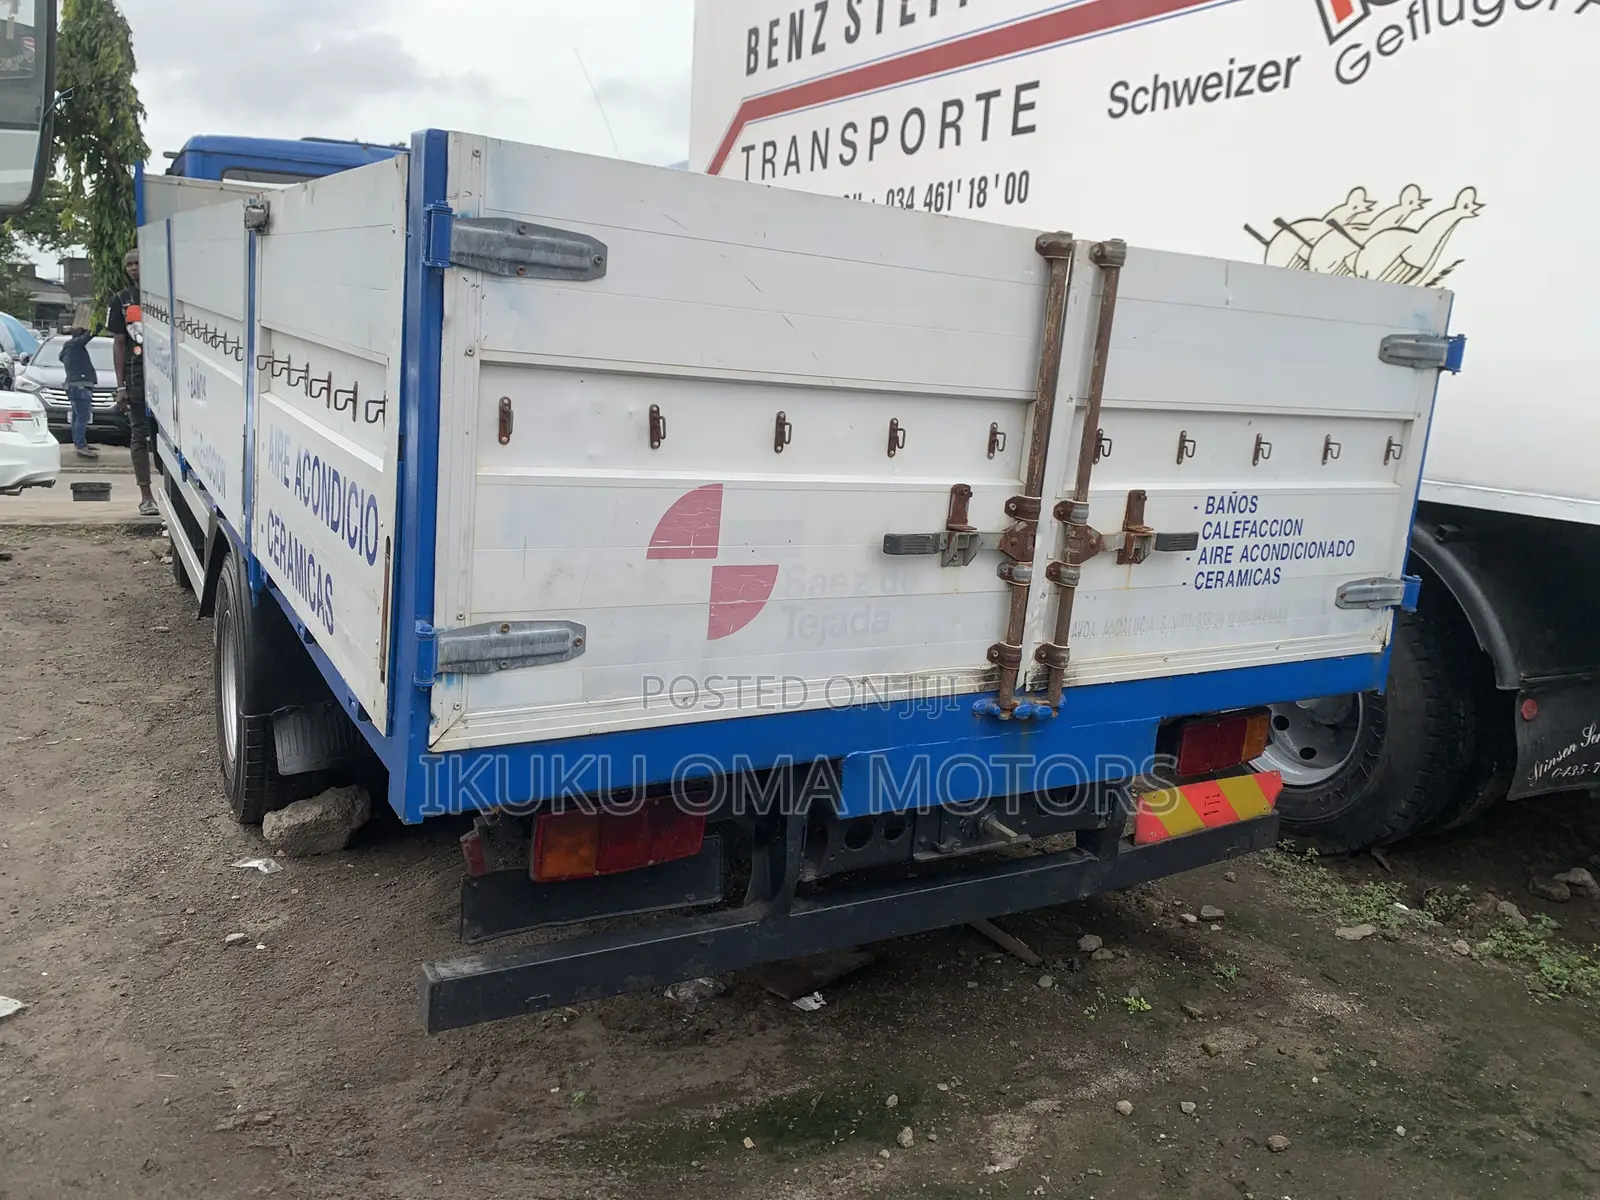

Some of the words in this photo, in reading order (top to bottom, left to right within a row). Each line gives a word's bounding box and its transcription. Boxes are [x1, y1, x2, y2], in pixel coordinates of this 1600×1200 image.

[746, 0, 829, 76] BENZ
[1107, 55, 1301, 119] Schweizer
[741, 80, 1040, 181] TRANSPORTE
[268, 423, 291, 490] AIRE
[295, 450, 379, 567] ACONDICIO
[1205, 491, 1259, 515] BAÑOS
[1198, 545, 1233, 566] AIRE
[1239, 540, 1355, 564] ACONDICIONADO
[1202, 518, 1304, 541] CALEFACCION
[267, 508, 334, 637] CERAMICAS
[1194, 567, 1282, 591] CERAMICAS
